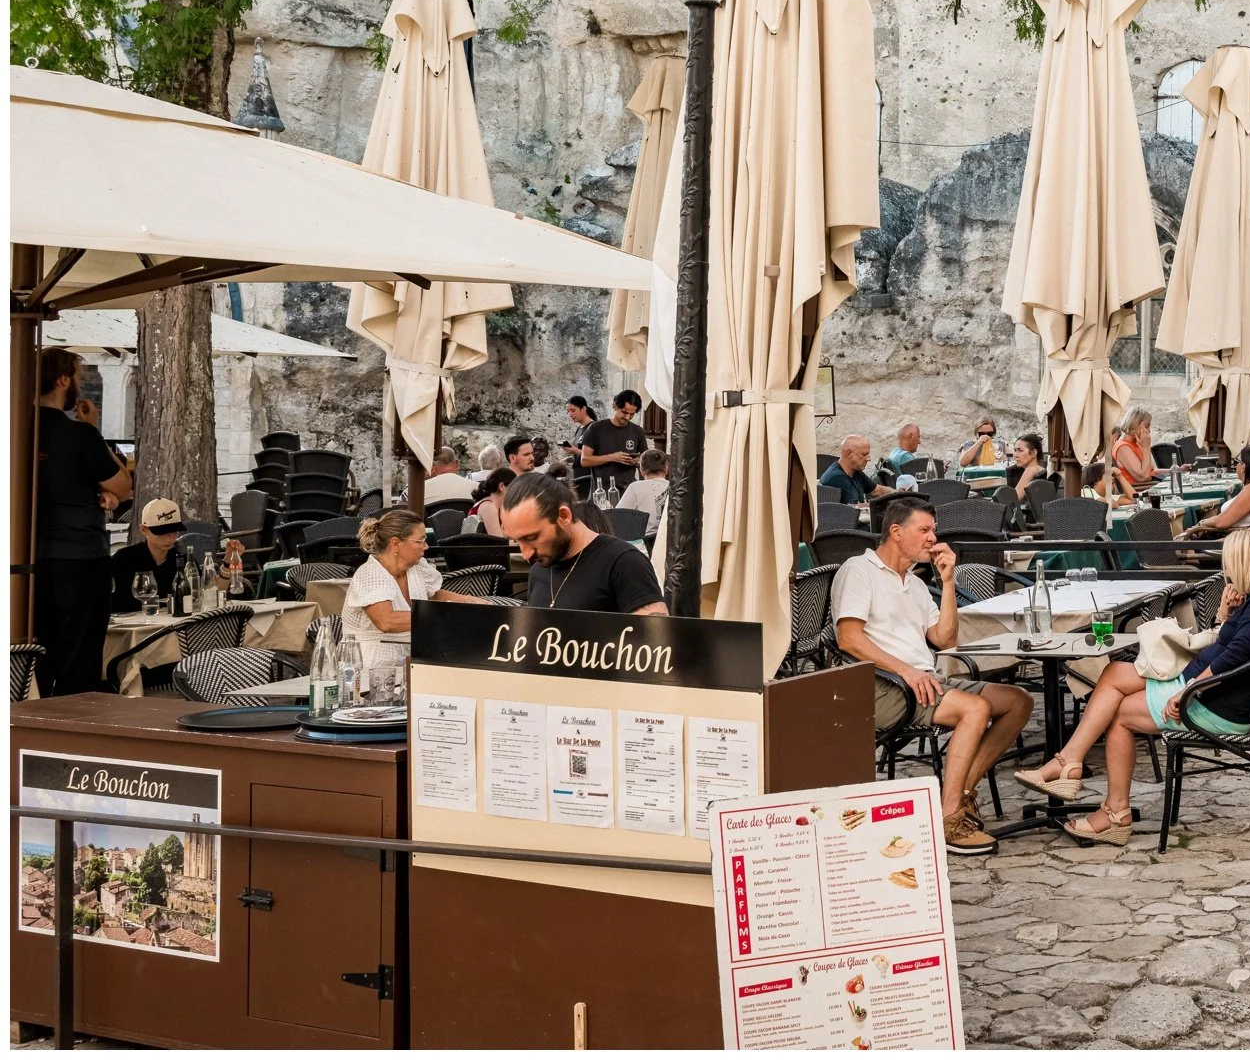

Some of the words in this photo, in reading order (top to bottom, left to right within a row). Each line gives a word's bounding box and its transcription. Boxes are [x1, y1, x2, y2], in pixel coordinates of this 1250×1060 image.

[487, 623, 527, 663] Le
[536, 626, 673, 675] Bouchon
[556, 737, 562, 745] Le
[66, 766, 90, 791] Le
[94, 769, 170, 800] Bouchon
[880, 806, 906, 816] Crêpes
[726, 818, 747, 830] Carte
[750, 815, 763, 828] des
[765, 813, 792, 829] Glaces
[735, 861, 749, 950] PARFUMS
[813, 961, 836, 973] Coupes
[838, 959, 846, 969] de
[846, 956, 868, 970] Glaces
[761, 983, 787, 991] Classique
